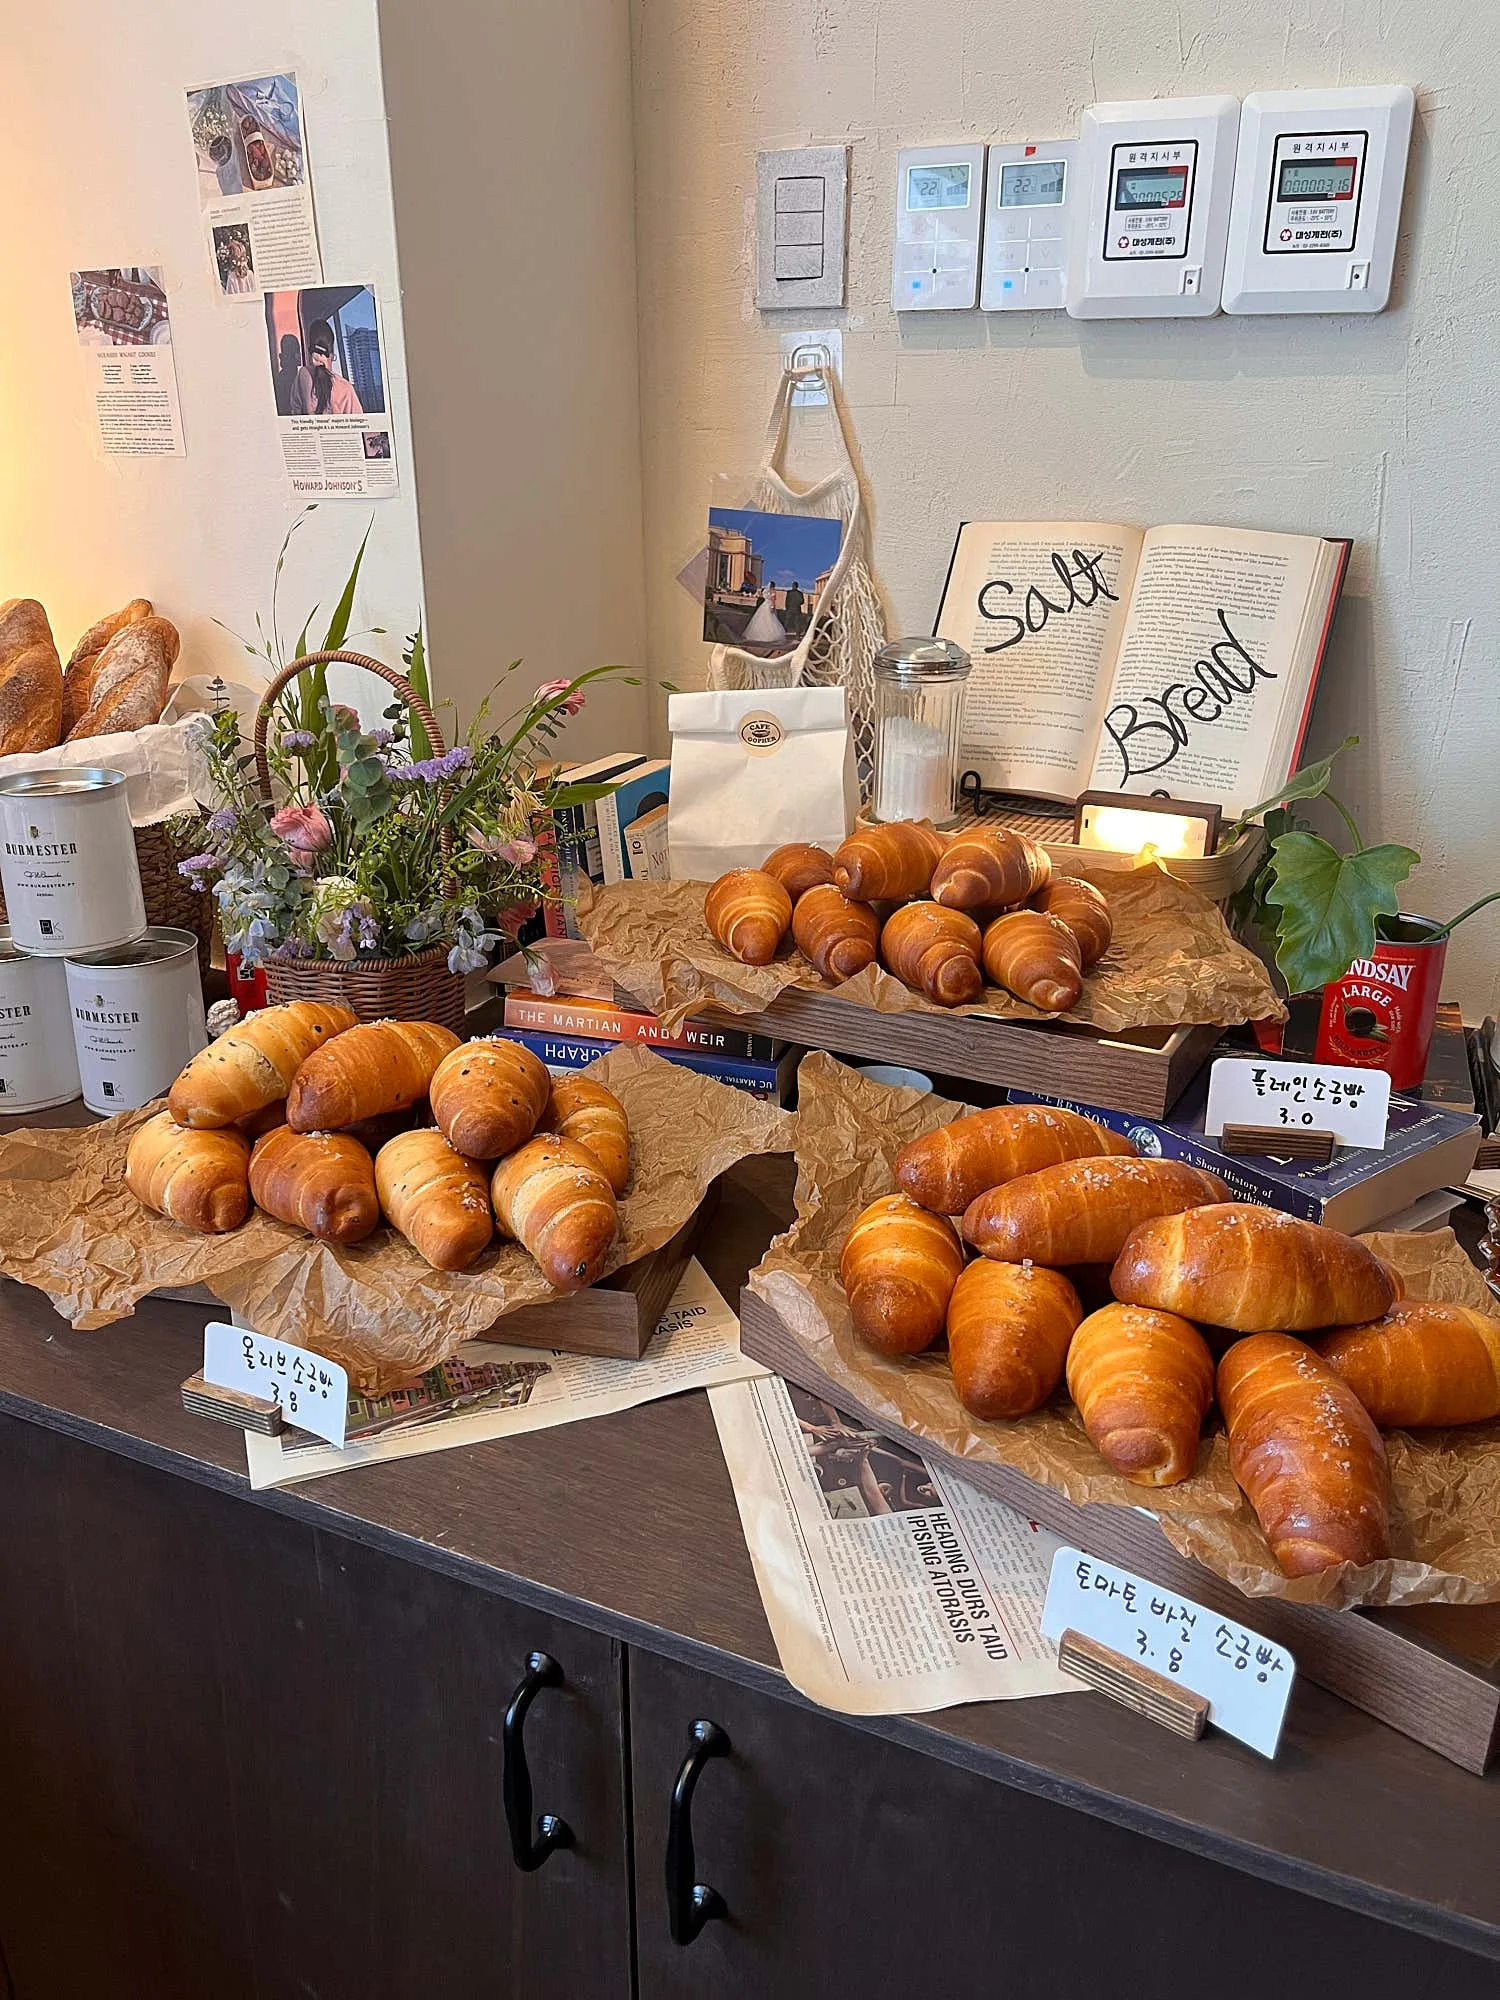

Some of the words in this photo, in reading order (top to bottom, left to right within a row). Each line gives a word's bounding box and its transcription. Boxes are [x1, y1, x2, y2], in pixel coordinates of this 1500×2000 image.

[1013, 178, 1032, 194] 22
[292, 479, 323, 491] HOWARD
[324, 480, 363, 492] JOHNSON'S
[977, 549, 1120, 653] Salt
[1104, 608, 1278, 789] Bread
[6, 843, 78, 856] BURMESTER
[1341, 984, 1392, 1007] LARGE
[519, 1009, 546, 1023] THE
[553, 1014, 621, 1033] MARTIAN
[637, 1025, 678, 1041] AND
[686, 1031, 725, 1047] WEIR
[759, 1081, 773, 1089] UC
[1279, 1107, 1314, 1125] 3.0
[1185, 1153, 1193, 1163] A
[1195, 1154, 1221, 1176] Short
[1223, 1168, 1259, 1196] History
[1262, 1188, 1273, 1201] of
[670, 1306, 707, 1319] TAID
[271, 1382, 298, 1413] 3.8
[906, 1514, 934, 1567] IPISING
[930, 1569, 976, 1645] ATORASIS
[928, 1511, 970, 1576] HEADING
[958, 1575, 990, 1620] DURS
[976, 1621, 1009, 1662] TAID
[1136, 1629, 1183, 1673] 3.8
[1150, 1597, 1197, 1643] 바질
[1215, 1624, 1284, 1683] 소금빵
